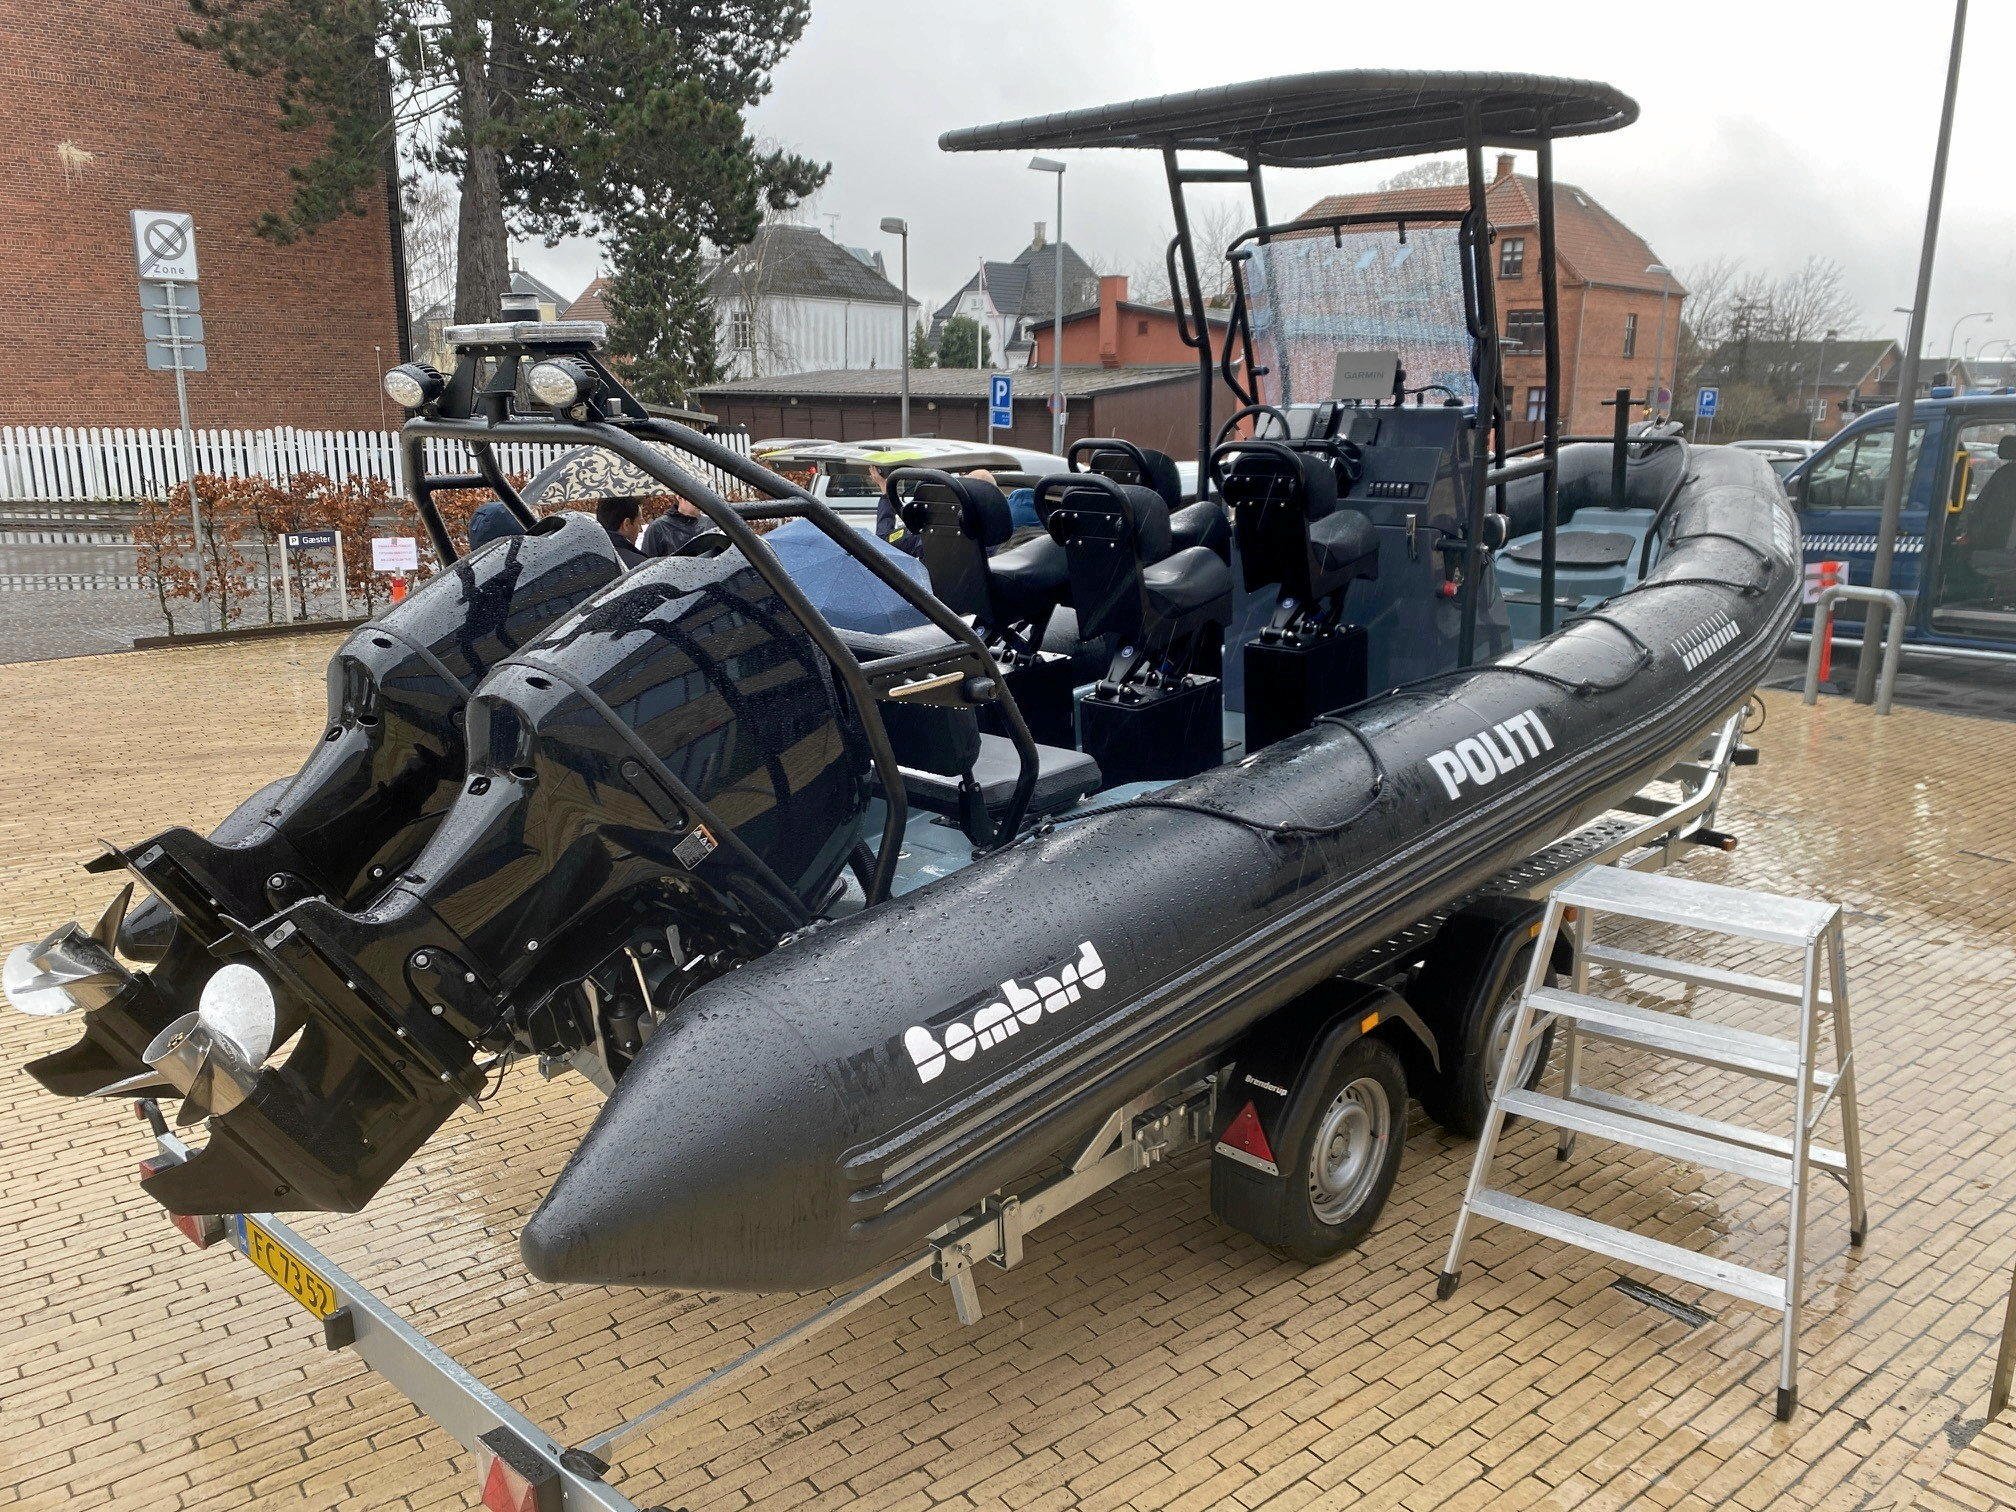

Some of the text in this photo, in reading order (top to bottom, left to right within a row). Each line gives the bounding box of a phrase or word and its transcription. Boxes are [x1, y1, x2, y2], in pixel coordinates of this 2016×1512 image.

[153, 264, 185, 275] Zone
[1344, 370, 1385, 380] GARMIN
[996, 380, 1008, 405] P
[1702, 391, 1714, 405] P
[302, 535, 331, 545] Gæster
[1427, 709, 1555, 800] POLITI
[904, 940, 1107, 1084] Bombard
[1245, 1074, 1288, 1096] Brenderup
